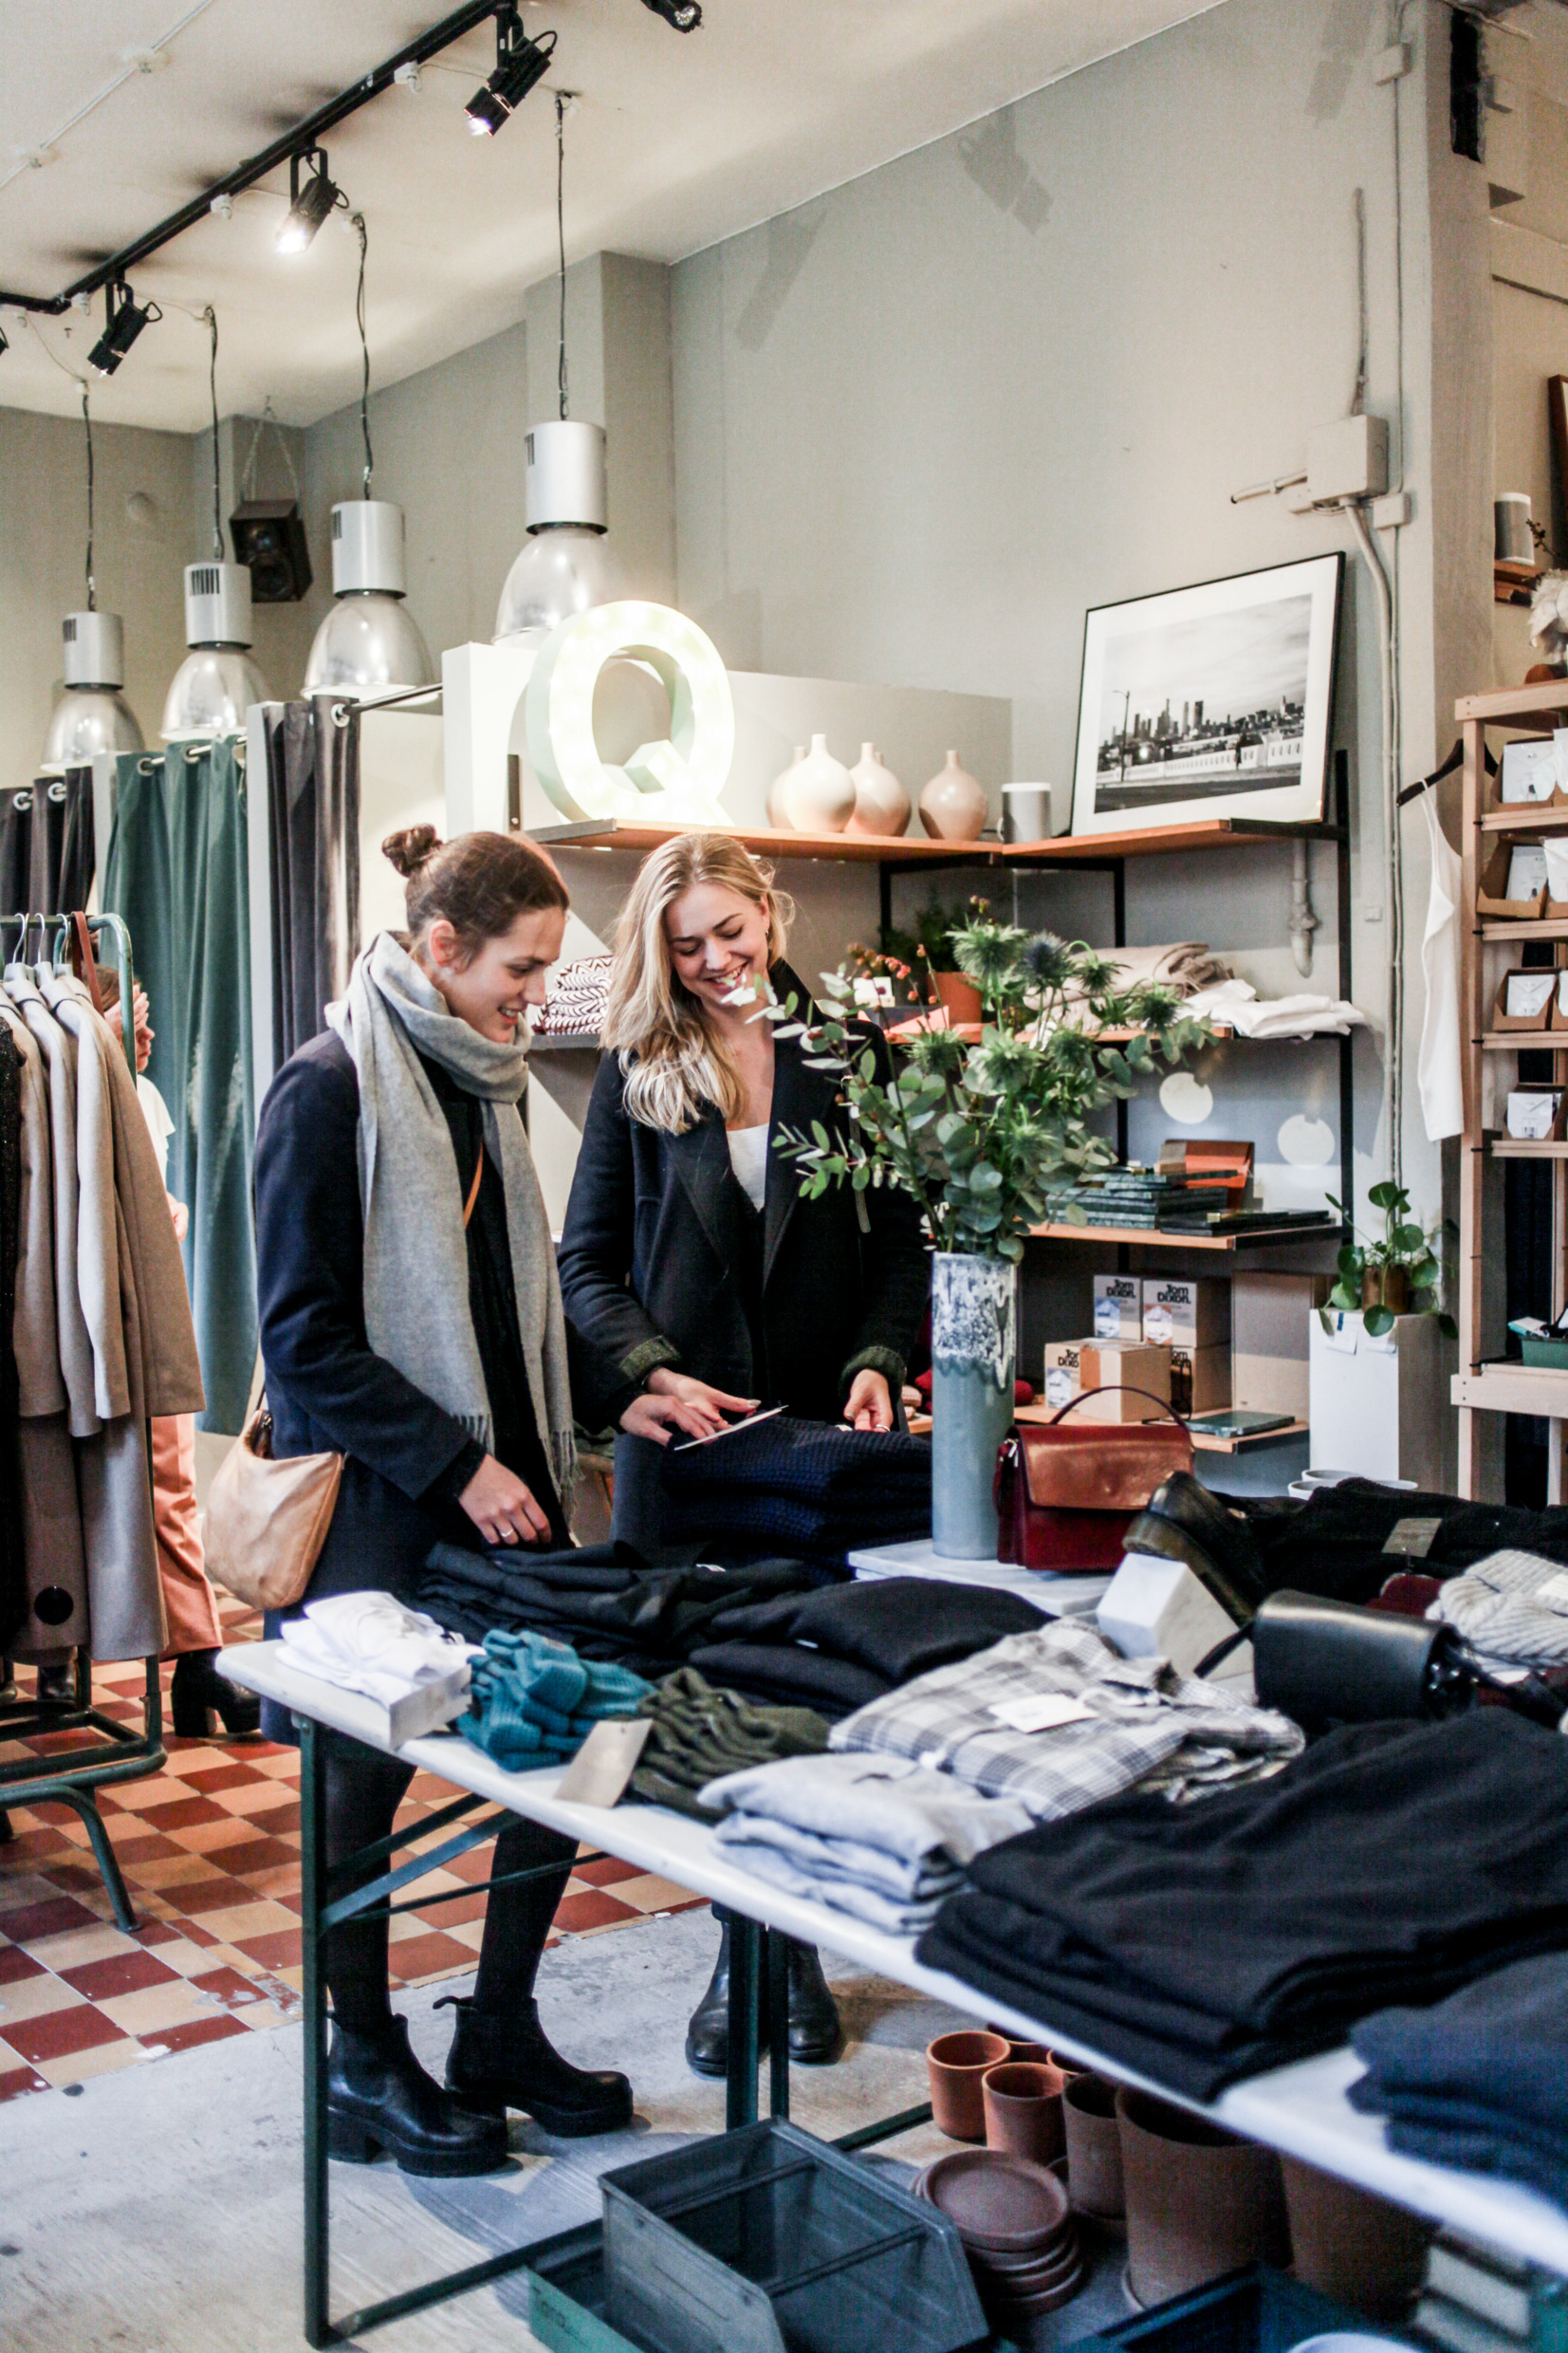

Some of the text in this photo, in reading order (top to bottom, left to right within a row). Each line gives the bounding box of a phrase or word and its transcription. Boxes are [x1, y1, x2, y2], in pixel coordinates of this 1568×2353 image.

[527, 600, 735, 826] Q
[1115, 1279, 1134, 1290] Tom
[1167, 1284, 1189, 1294] Tom
[1106, 1287, 1136, 1298] Dixon.
[1157, 1290, 1191, 1304] Dixon.
[1058, 1356, 1079, 1367] Dixo
